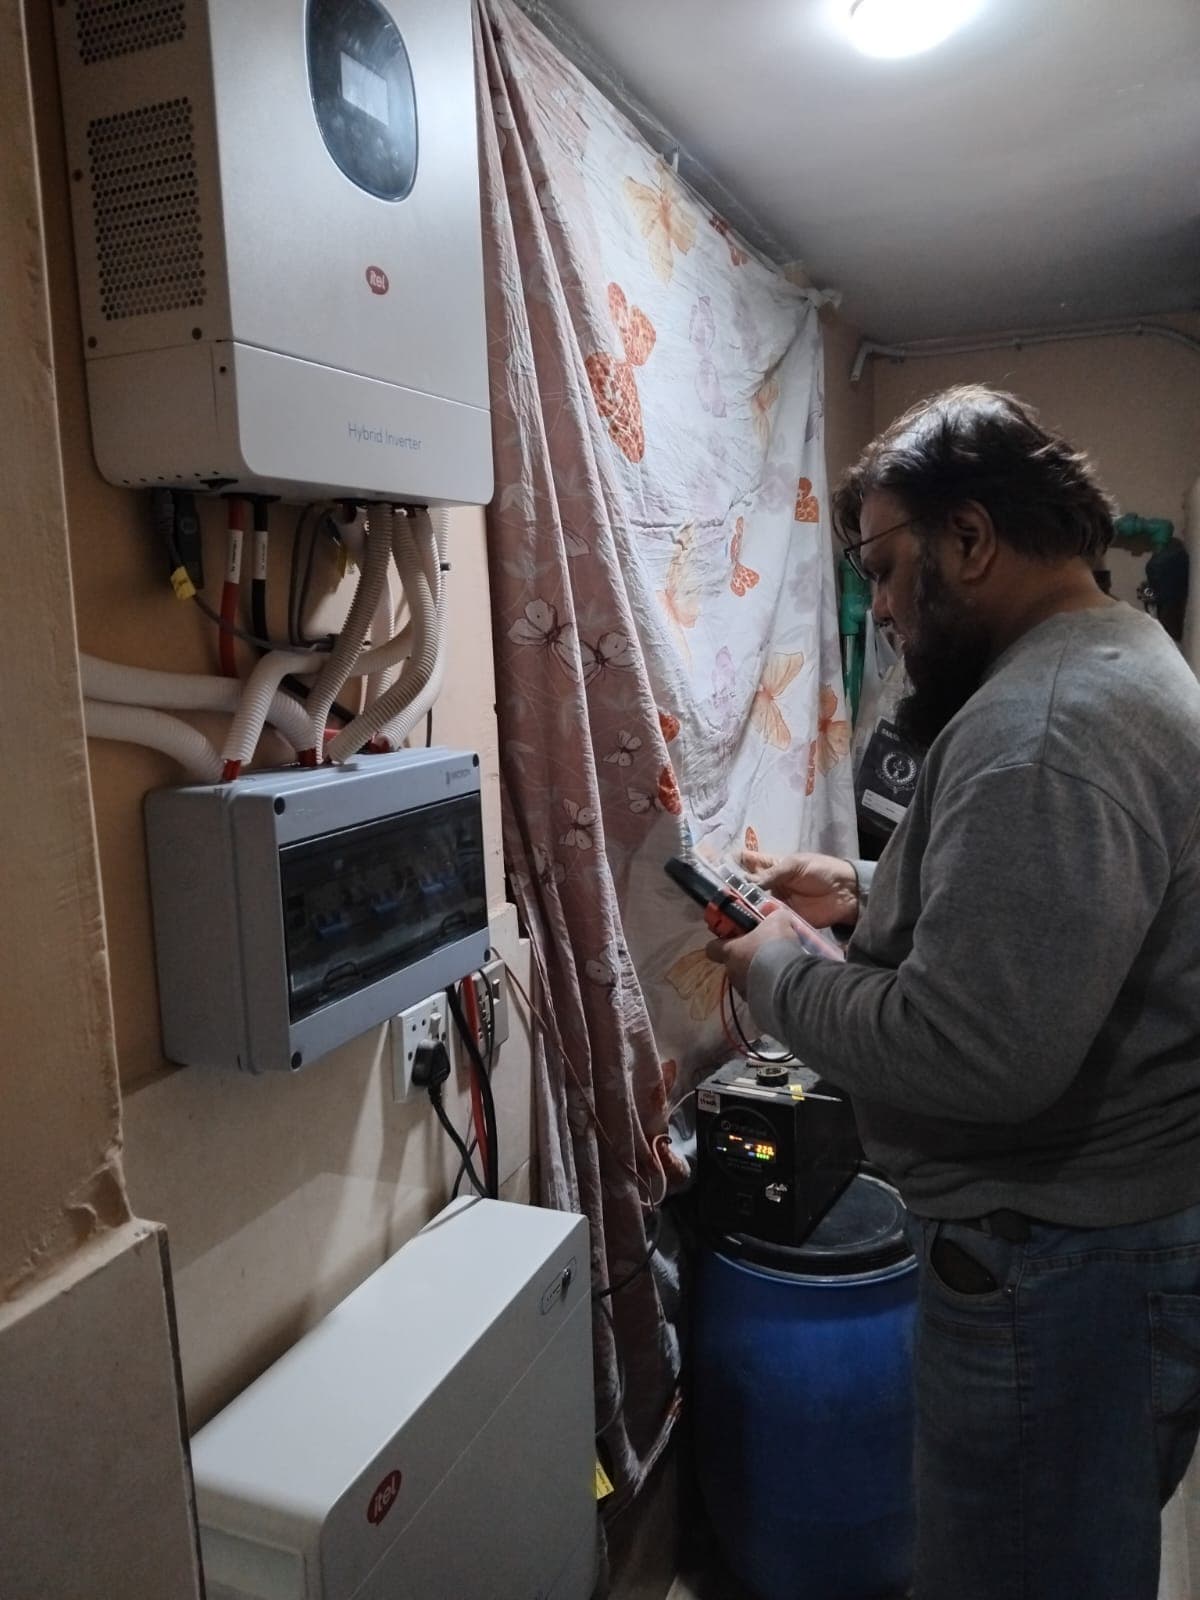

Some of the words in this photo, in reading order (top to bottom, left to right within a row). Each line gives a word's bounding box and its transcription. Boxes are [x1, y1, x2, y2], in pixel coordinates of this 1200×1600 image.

[369, 269, 386, 291] itel
[347, 420, 383, 444] Hybrid
[384, 427, 422, 450] Inverter
[373, 1474, 397, 1519] itel
